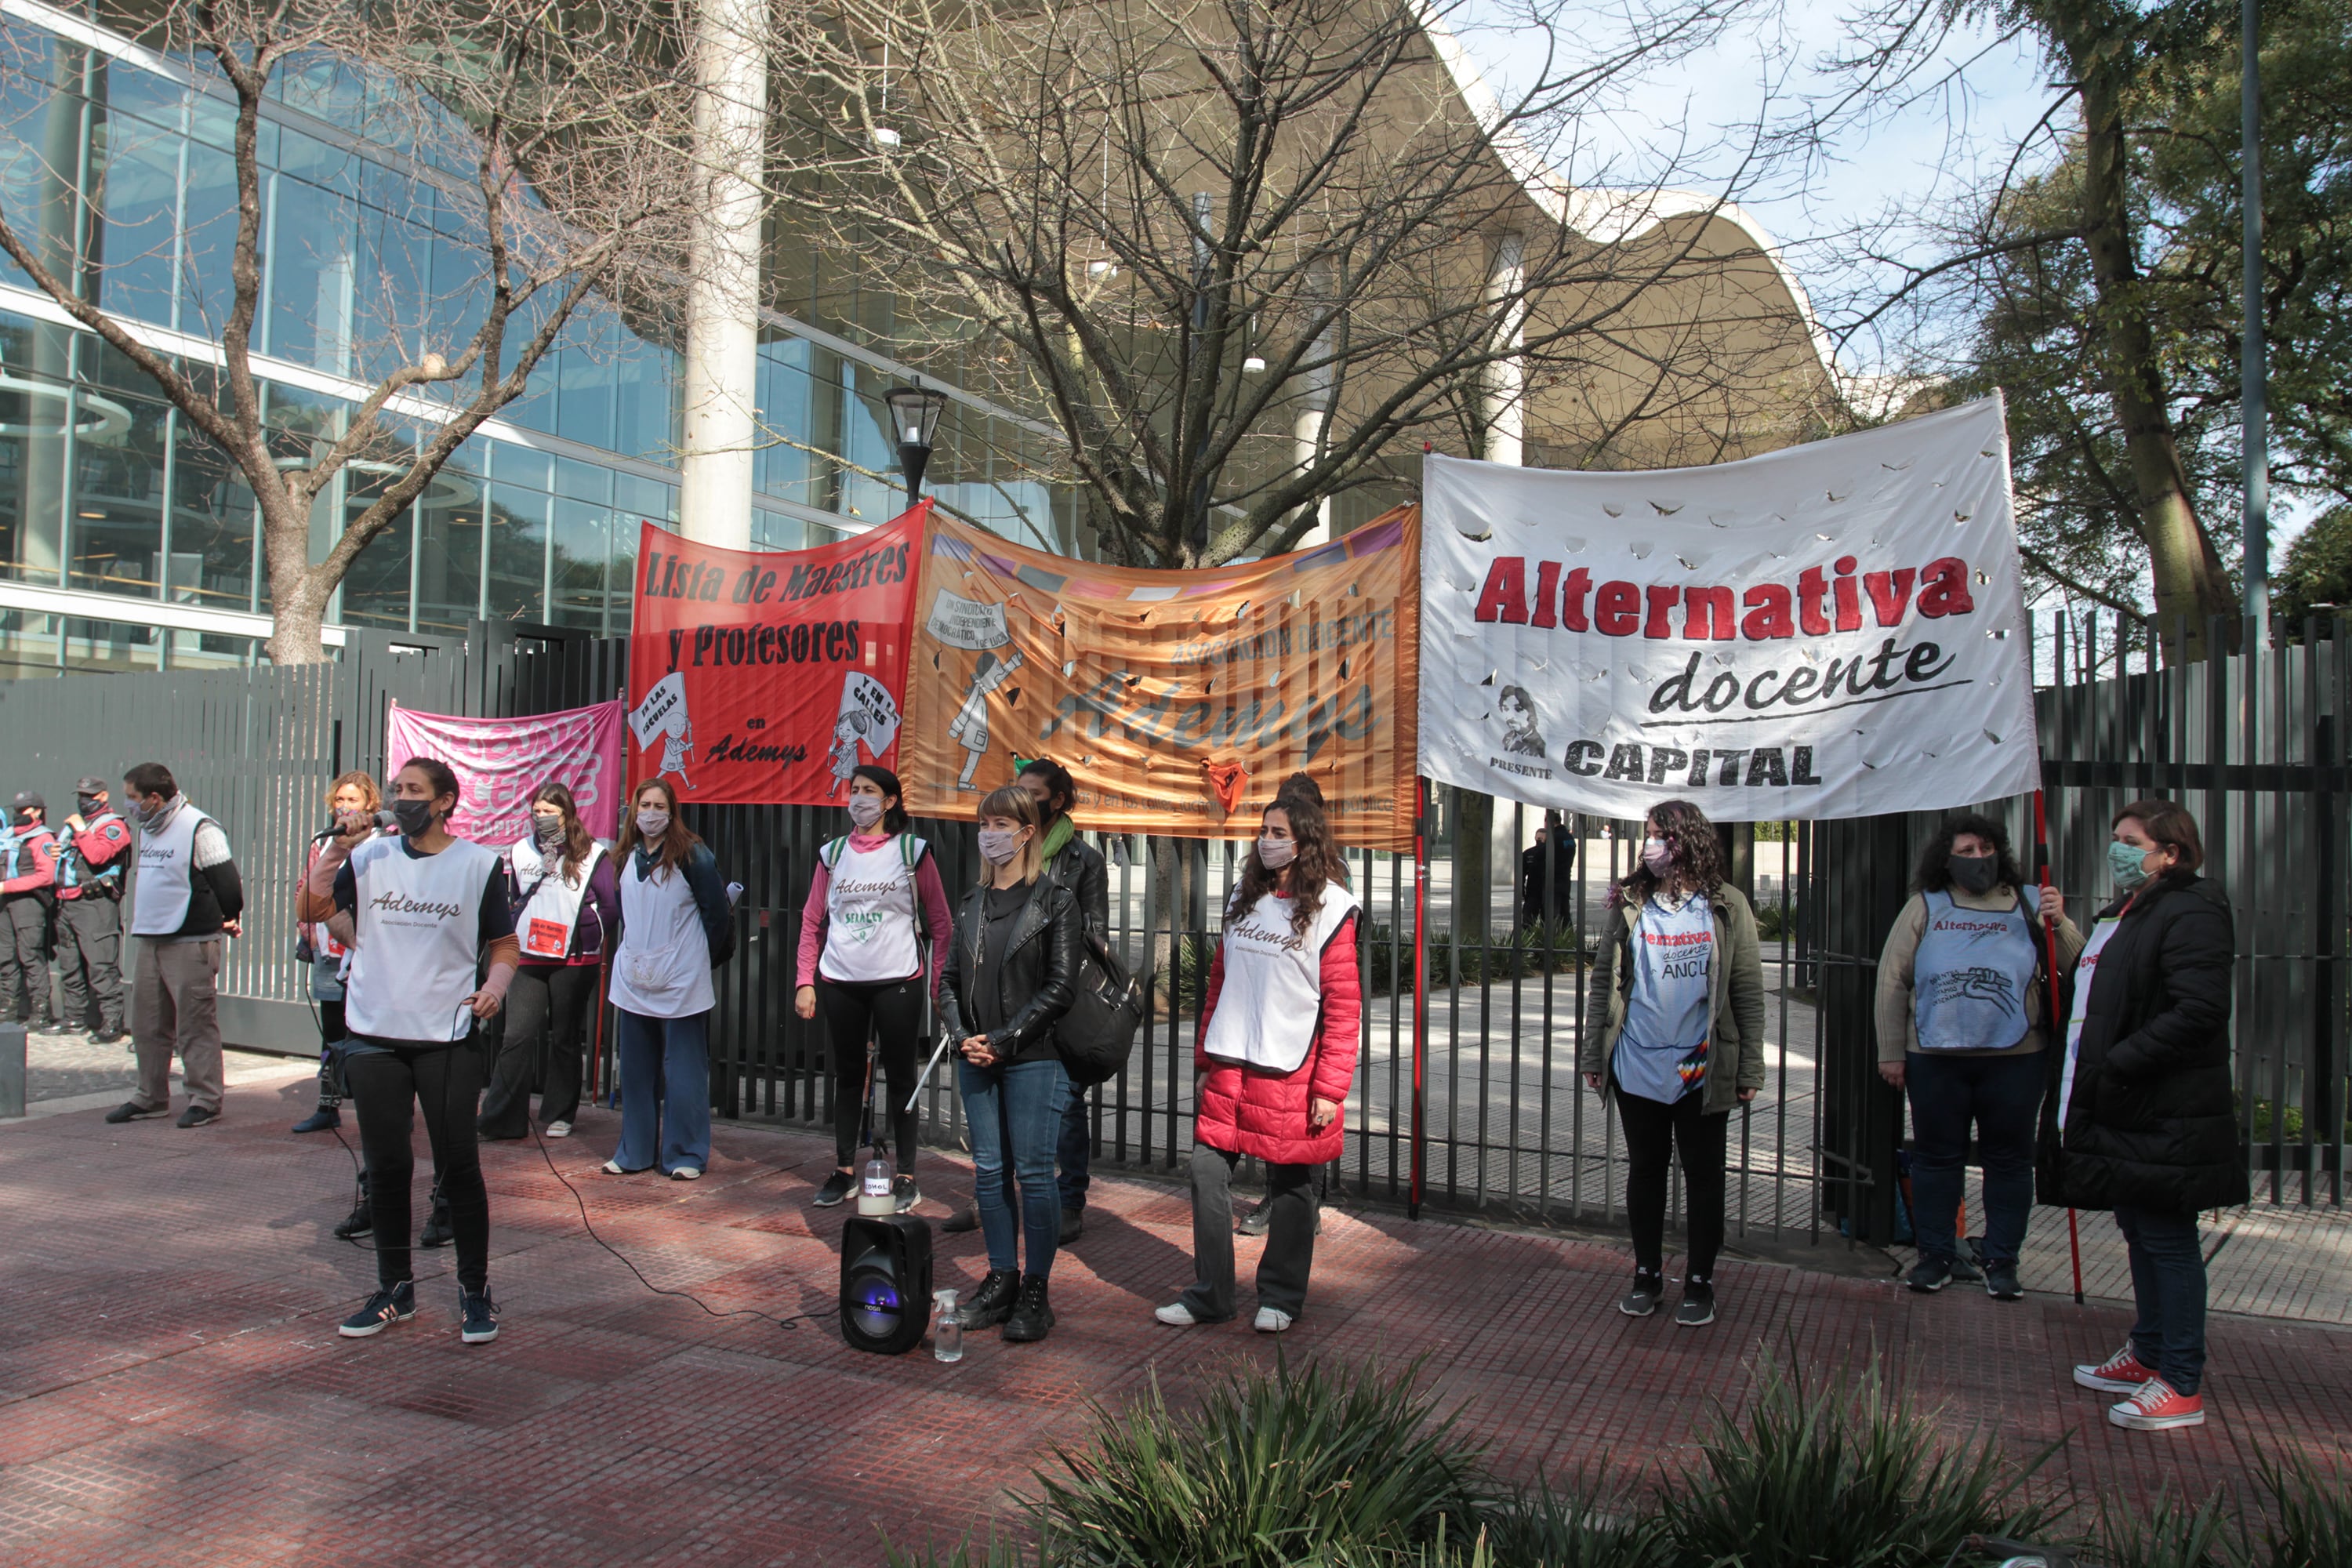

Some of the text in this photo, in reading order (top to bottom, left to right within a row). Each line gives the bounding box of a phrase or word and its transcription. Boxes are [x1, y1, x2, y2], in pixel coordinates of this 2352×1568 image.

[644, 542, 909, 604] Lista de Maestres
[954, 601, 993, 615] SINDICATO
[1474, 555, 1976, 642] Alternativa
[931, 617, 975, 641] DEMOCRÁTICO
[949, 615, 996, 628] INDEPENDIENTE
[1298, 608, 1393, 653] DOCENTE
[667, 619, 859, 672] y Profesores
[980, 638, 988, 648] DE
[863, 676, 869, 688] Y
[870, 686, 884, 705] EN
[1647, 639, 1955, 716] docente
[650, 685, 666, 705] LAS
[854, 687, 887, 726] CALLES
[746, 717, 765, 729] en
[1040, 670, 1382, 767] Ademys
[705, 734, 808, 769] Ademys
[1563, 739, 1822, 786] CAPITAL
[1490, 757, 1552, 780] PRESENTE
[1105, 794, 1119, 807] en
[1341, 795, 1393, 816] pública
[471, 818, 534, 837] CAPITA
[836, 879, 898, 895] Ademys
[369, 891, 461, 920] Ademys
[1230, 920, 1304, 953] Ademys
[1663, 943, 1708, 960] docente
